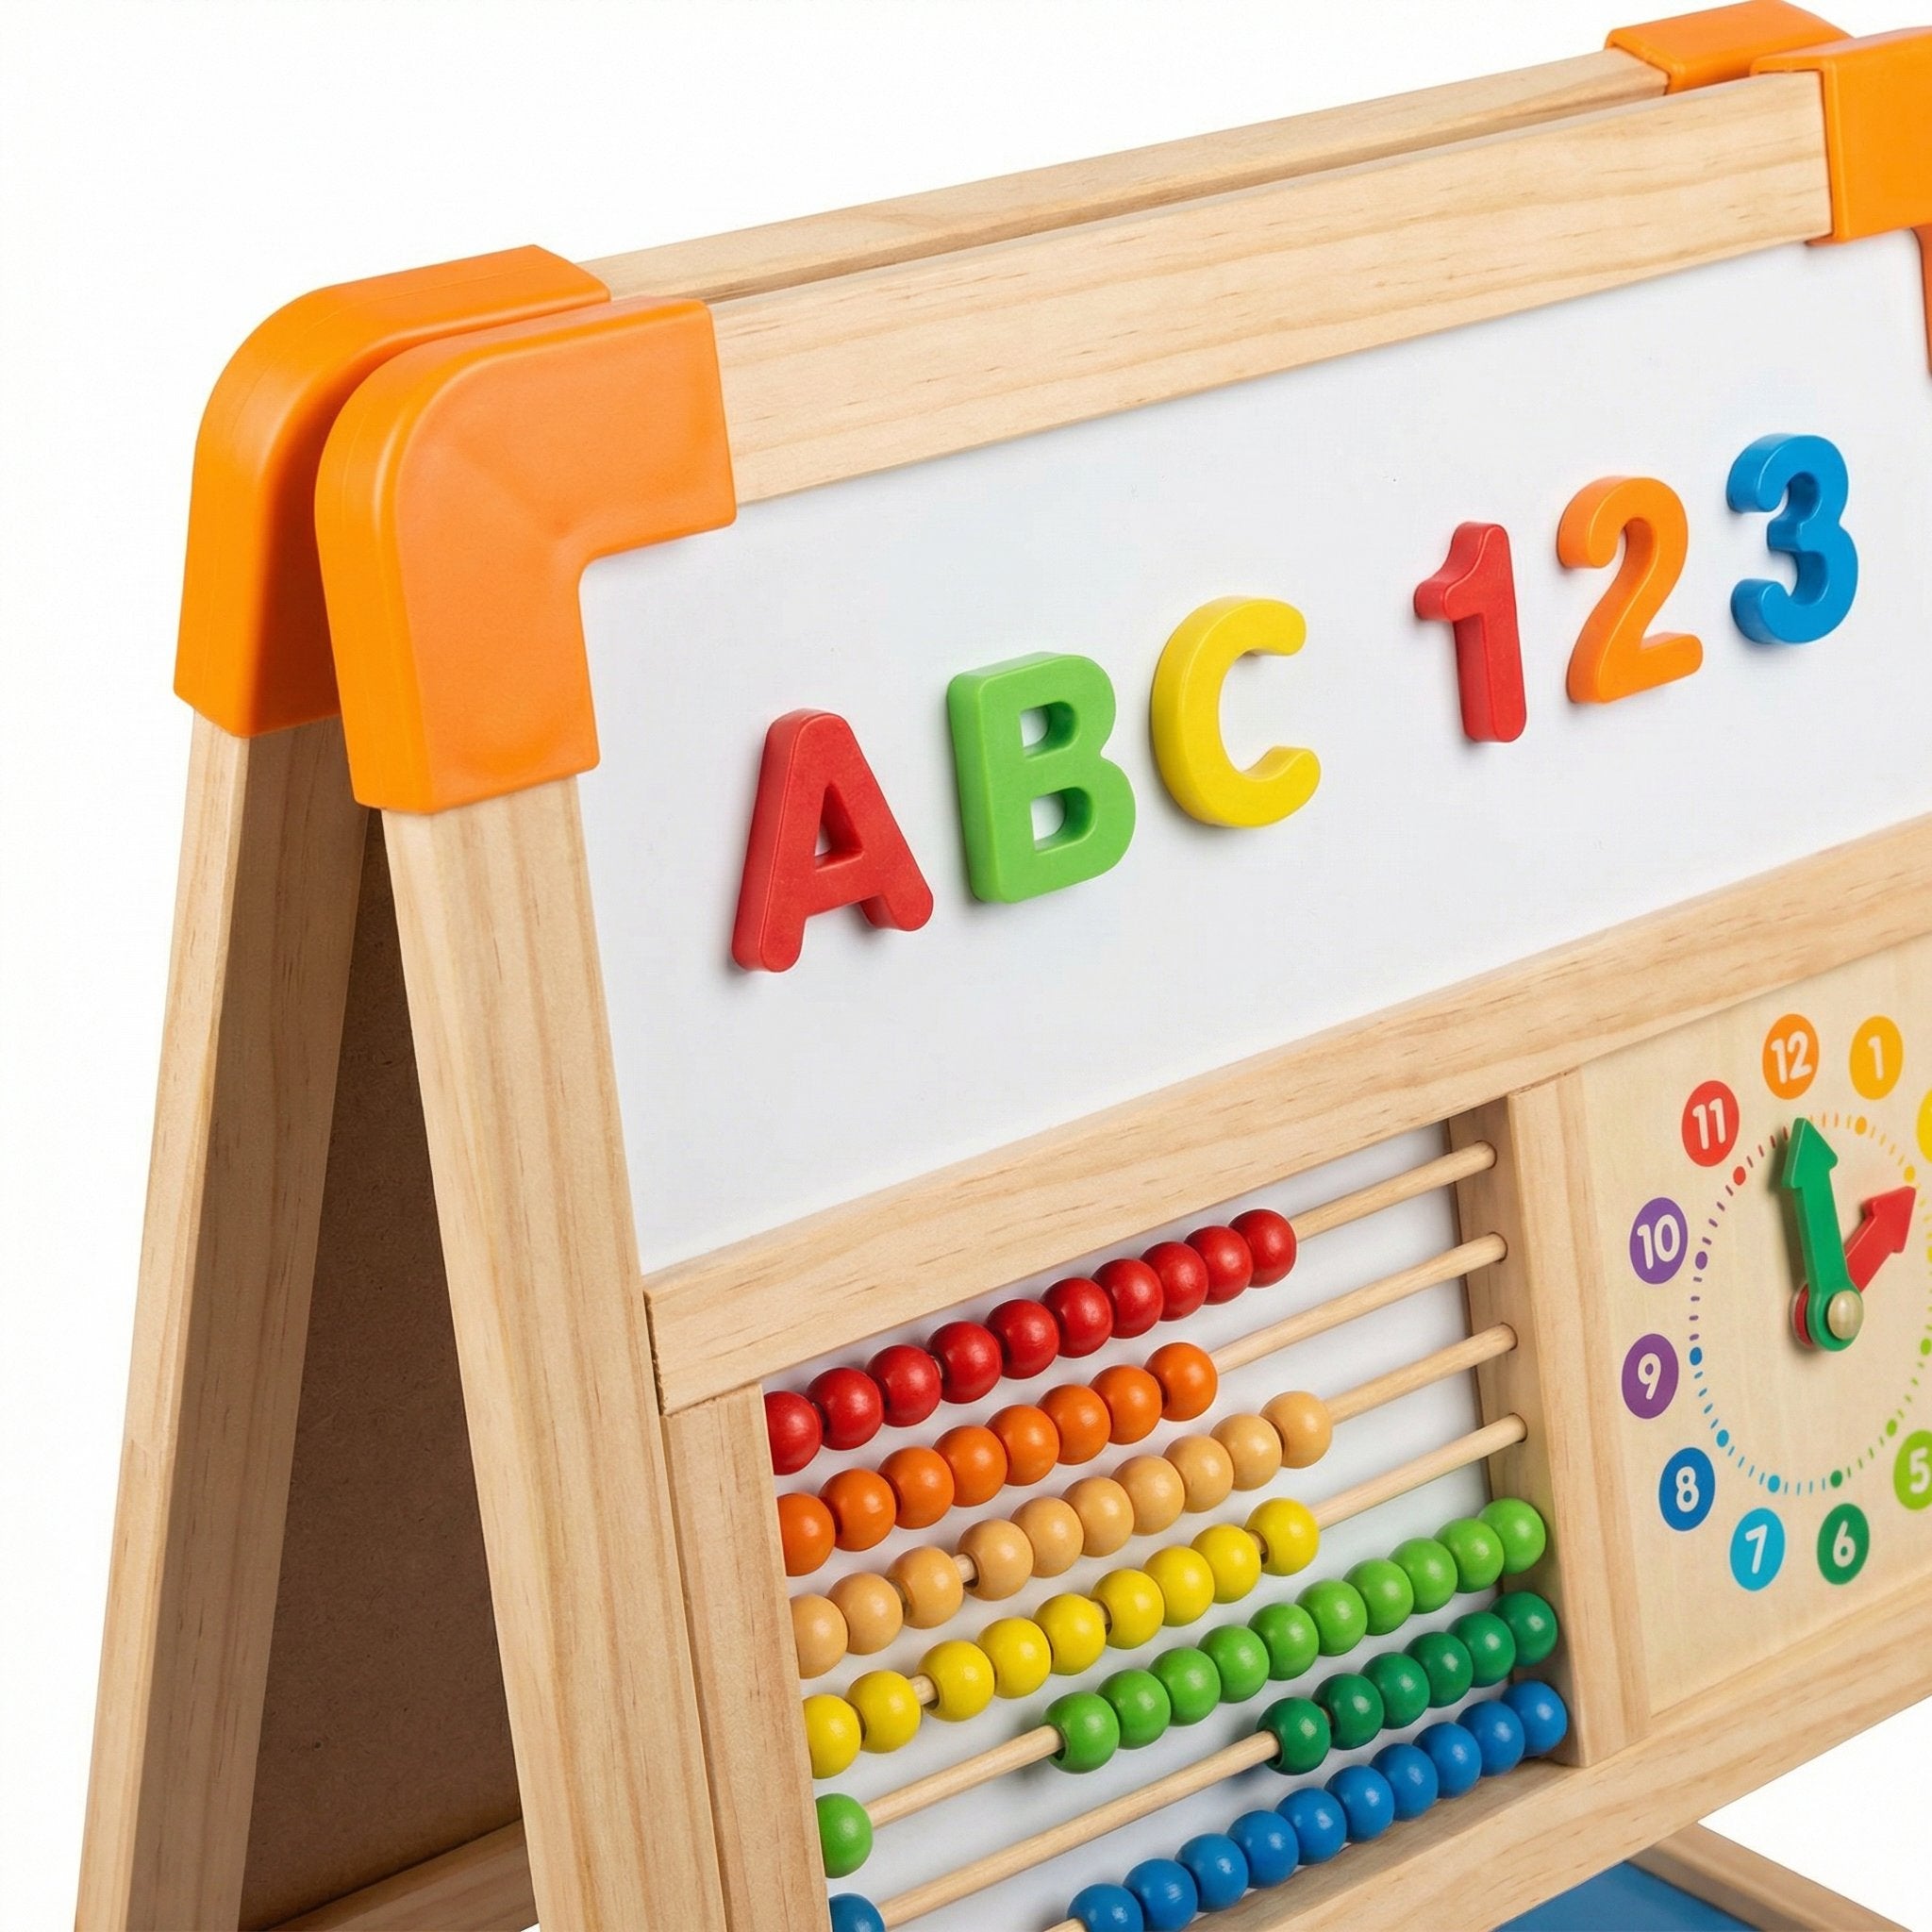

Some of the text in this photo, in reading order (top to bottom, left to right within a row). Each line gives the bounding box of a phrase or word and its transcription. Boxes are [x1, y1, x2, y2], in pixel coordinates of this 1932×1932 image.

[731, 433, 1858, 973] ABC 123
[1770, 1030, 1812, 1084] 12
[1867, 1035, 1885, 1080] 1
[1691, 1097, 1726, 1150] 11
[1636, 1213, 1681, 1270] 10
[1637, 1352, 1662, 1401] 9
[1674, 1465, 1700, 1513] 8
[1909, 1447, 1932, 1494] 5
[1744, 1524, 1768, 1574] 7
[1831, 1520, 1857, 1569] 6
